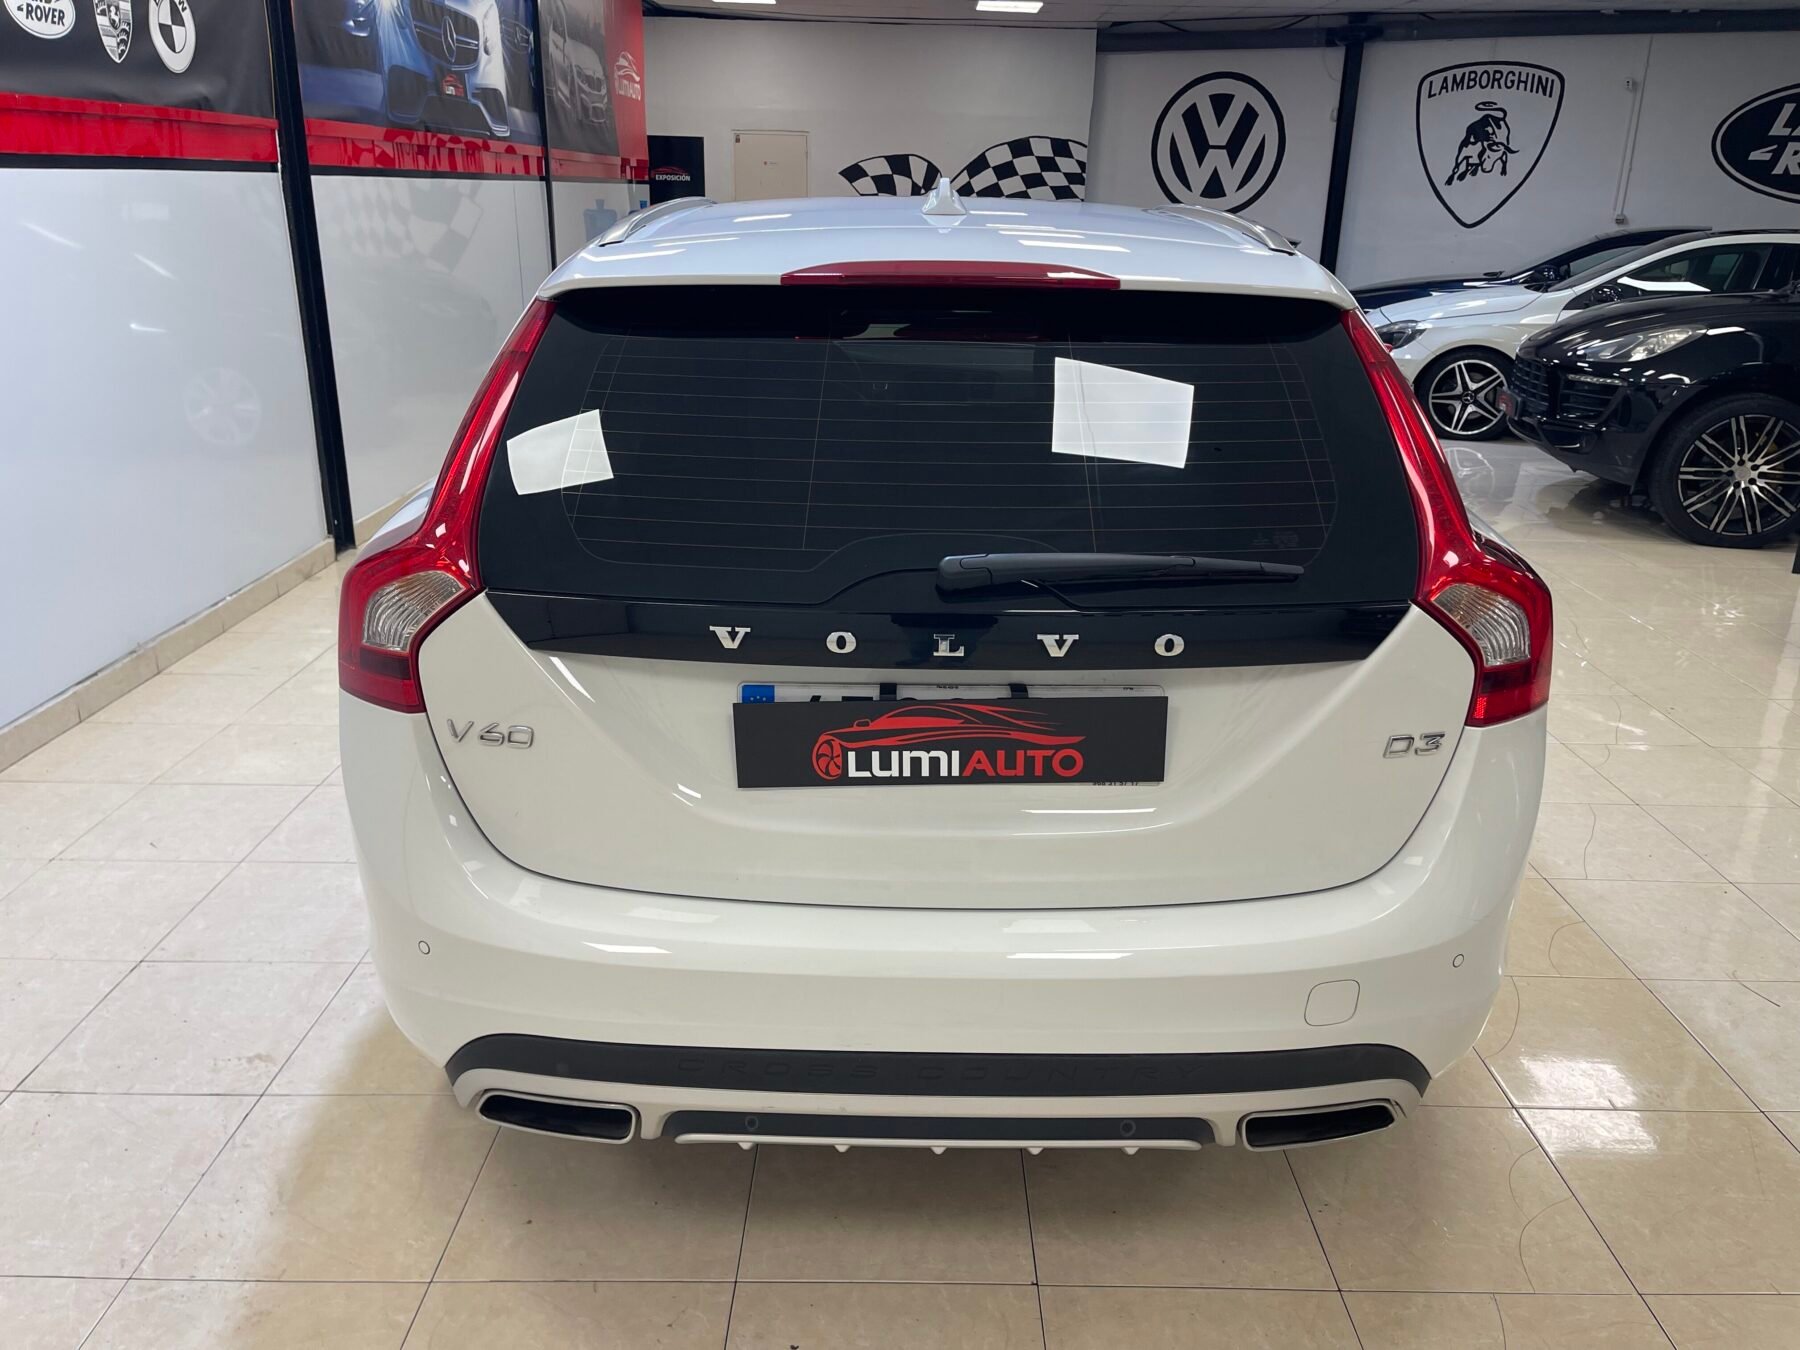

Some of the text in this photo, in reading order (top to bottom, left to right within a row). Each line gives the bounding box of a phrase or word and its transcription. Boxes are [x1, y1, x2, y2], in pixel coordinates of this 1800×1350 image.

[25, 2, 66, 27] ROVER
[1427, 69, 1555, 98] LAMBORGHINI
[655, 173, 691, 182] EXPOSICIÓN
[709, 625, 1185, 658] VOLVO
[446, 718, 534, 750] V60
[1382, 731, 1446, 759] D3
[677, 1058, 1206, 1082] CROSS COUNTRY
